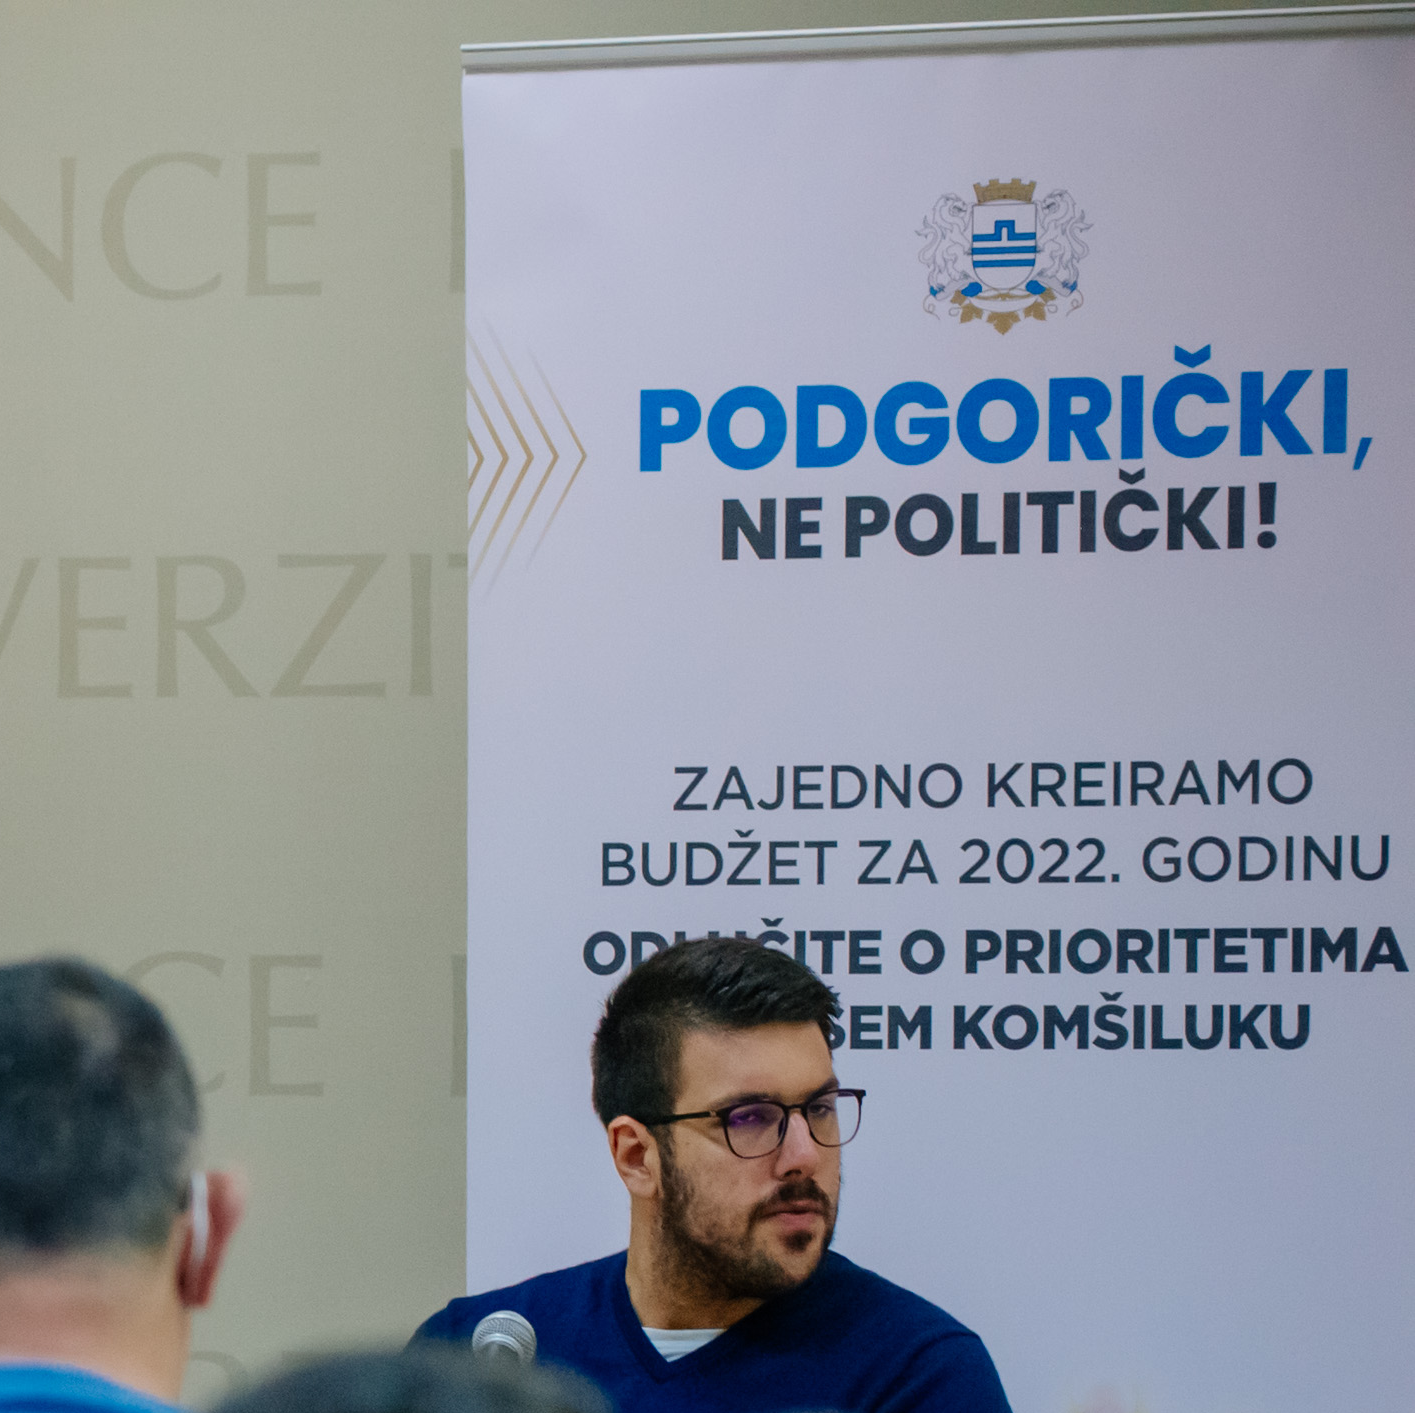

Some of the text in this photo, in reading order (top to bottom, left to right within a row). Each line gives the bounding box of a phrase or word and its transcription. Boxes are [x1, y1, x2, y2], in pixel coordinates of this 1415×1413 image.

[640, 344, 1373, 471] PODGORIČKI,
[720, 468, 1277, 560] NE POLITIČKI!
[674, 758, 1313, 811] ZAJEDNO KREIRAMO
[602, 830, 1390, 886] BUDŽET ZA 2022. GODINU
[900, 929, 946, 975] O
[966, 926, 1410, 975] PRIORITETIMA
[954, 992, 1311, 1051] KOMŠILUKU
